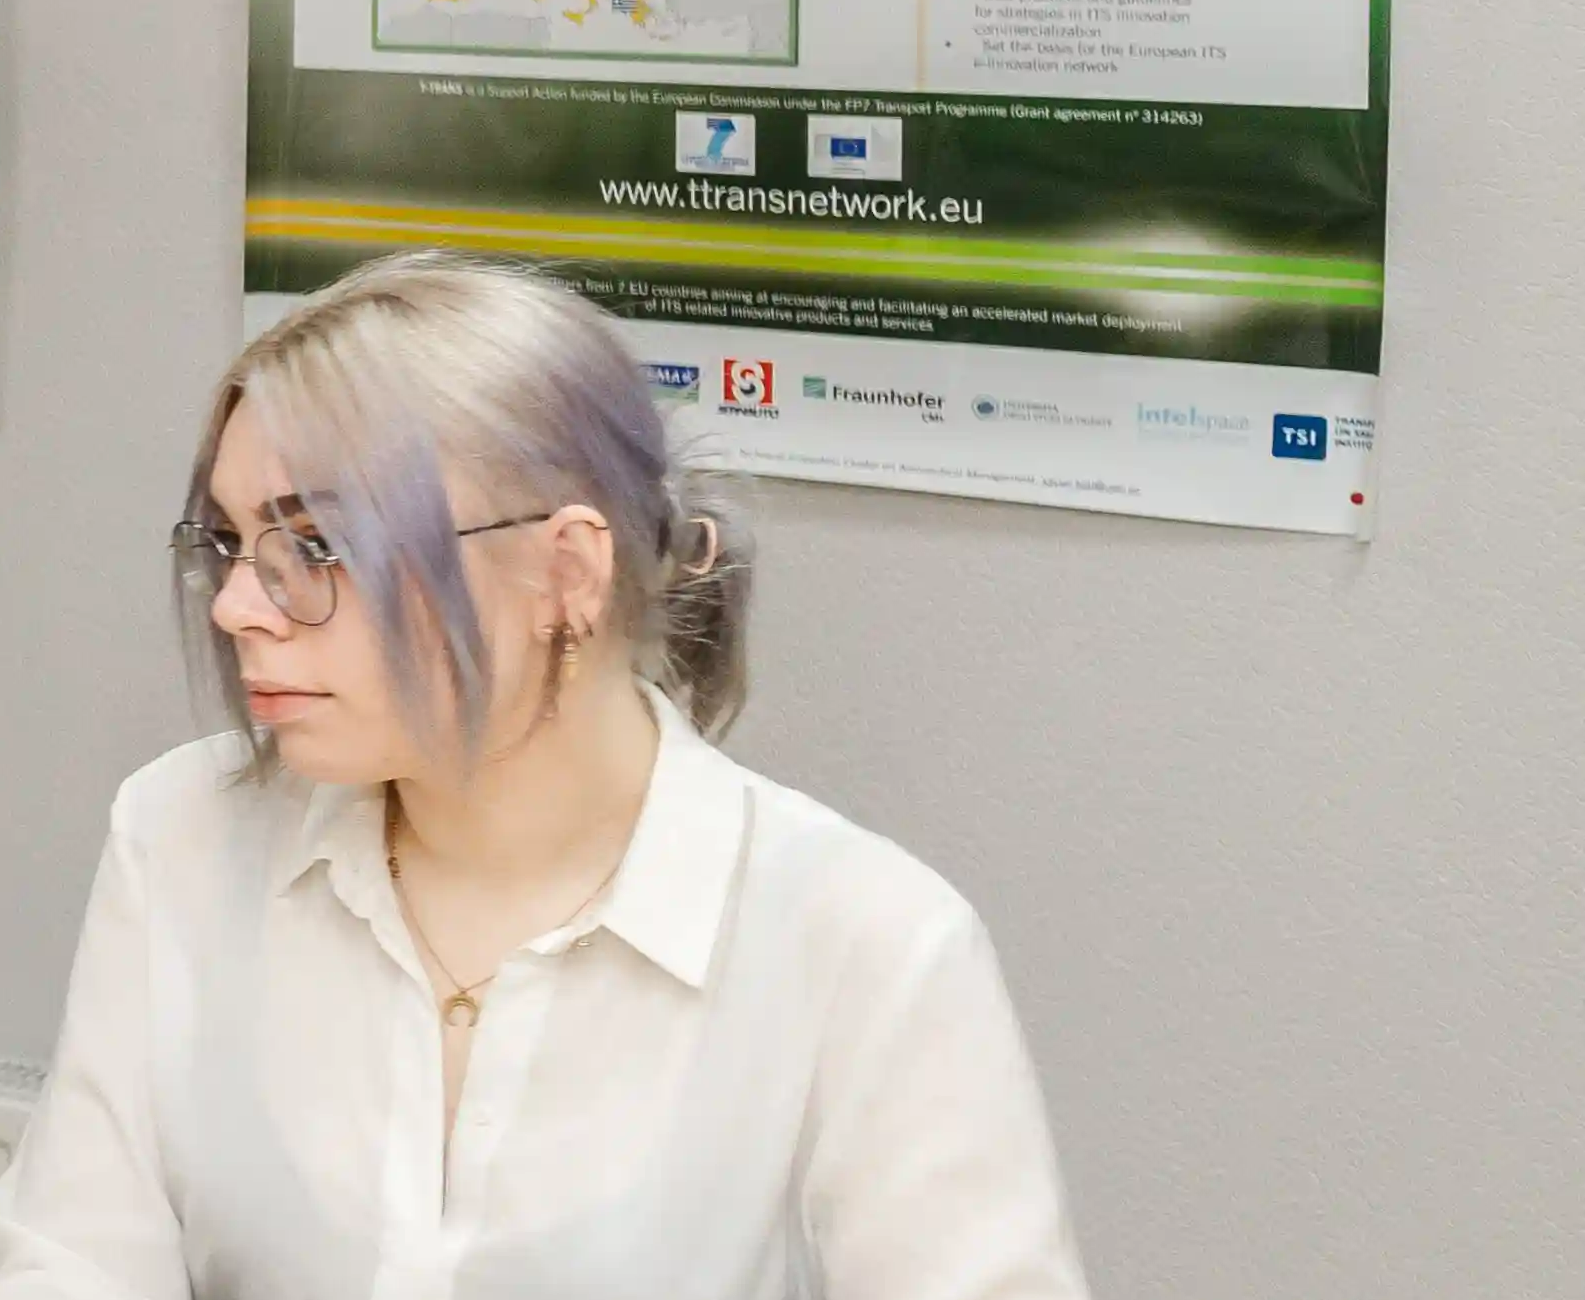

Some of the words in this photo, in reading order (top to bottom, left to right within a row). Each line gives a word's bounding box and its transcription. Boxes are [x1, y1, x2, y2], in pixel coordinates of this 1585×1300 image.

[599, 178, 983, 225] www.ttransnetwork.eu
[833, 385, 946, 412] Fraunhofer
[1281, 425, 1318, 449] TSI
